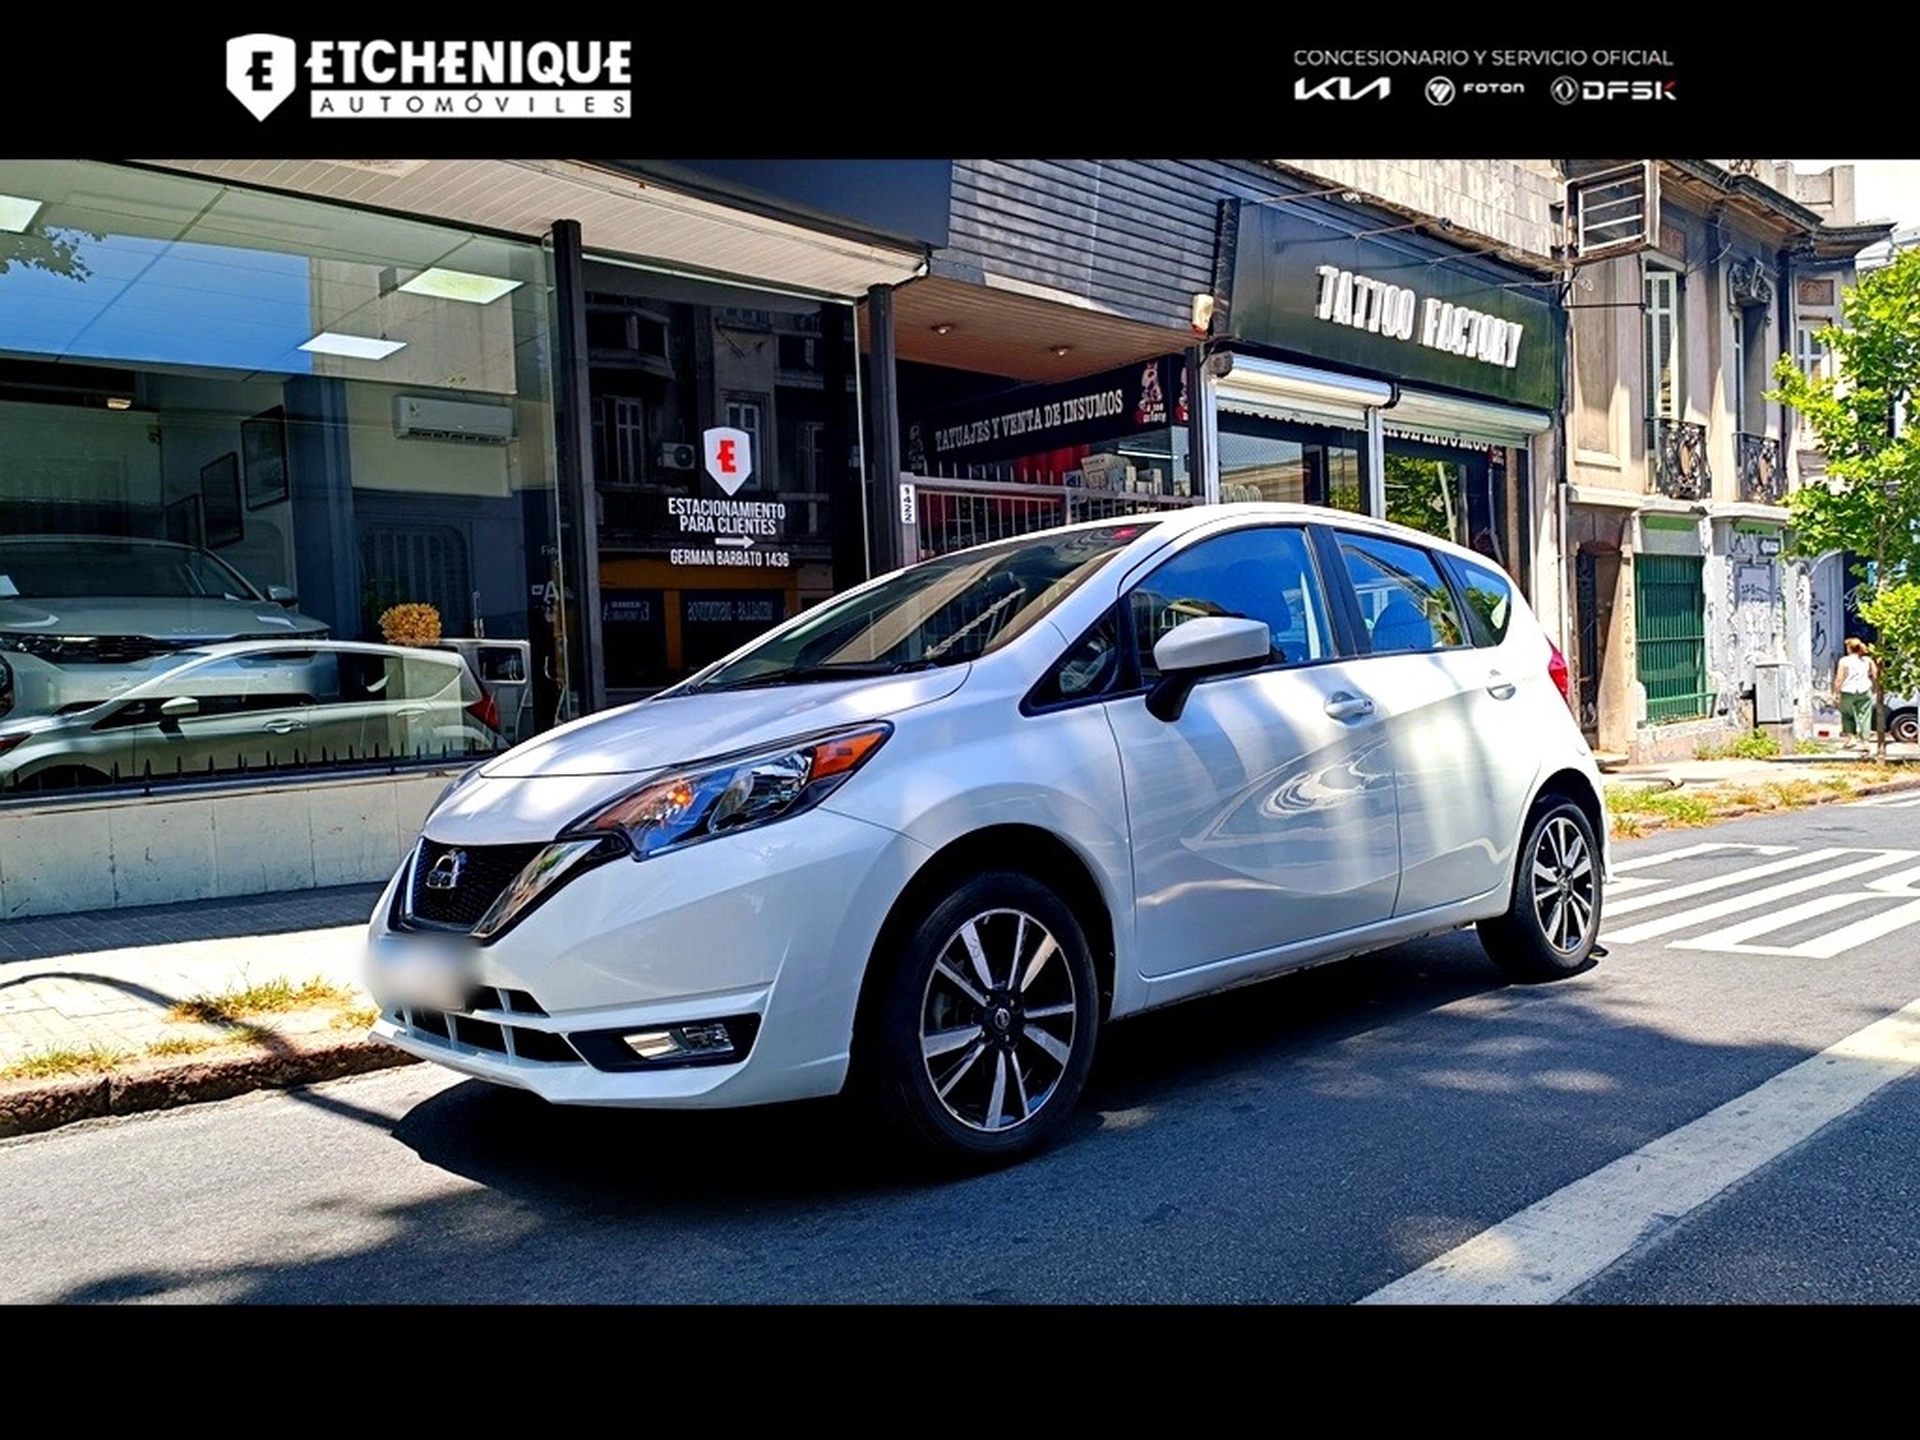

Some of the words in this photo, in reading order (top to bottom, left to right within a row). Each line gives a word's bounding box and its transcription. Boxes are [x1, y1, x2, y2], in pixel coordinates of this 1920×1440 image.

[1315, 265, 1416, 341] TATTOO
[1419, 298, 1524, 368] FACTORY
[934, 421, 990, 452] TATUAJES
[991, 418, 1001, 440] Y
[1001, 408, 1044, 437] VENTA
[1044, 402, 1062, 427] DE
[1062, 388, 1124, 425] INSUMOS
[667, 497, 786, 520] ESTACIONAMIENTO
[680, 515, 715, 533] PARA
[717, 517, 777, 535] CLIENTES
[670, 549, 715, 565] GERMAN
[716, 550, 763, 567] BARBATO
